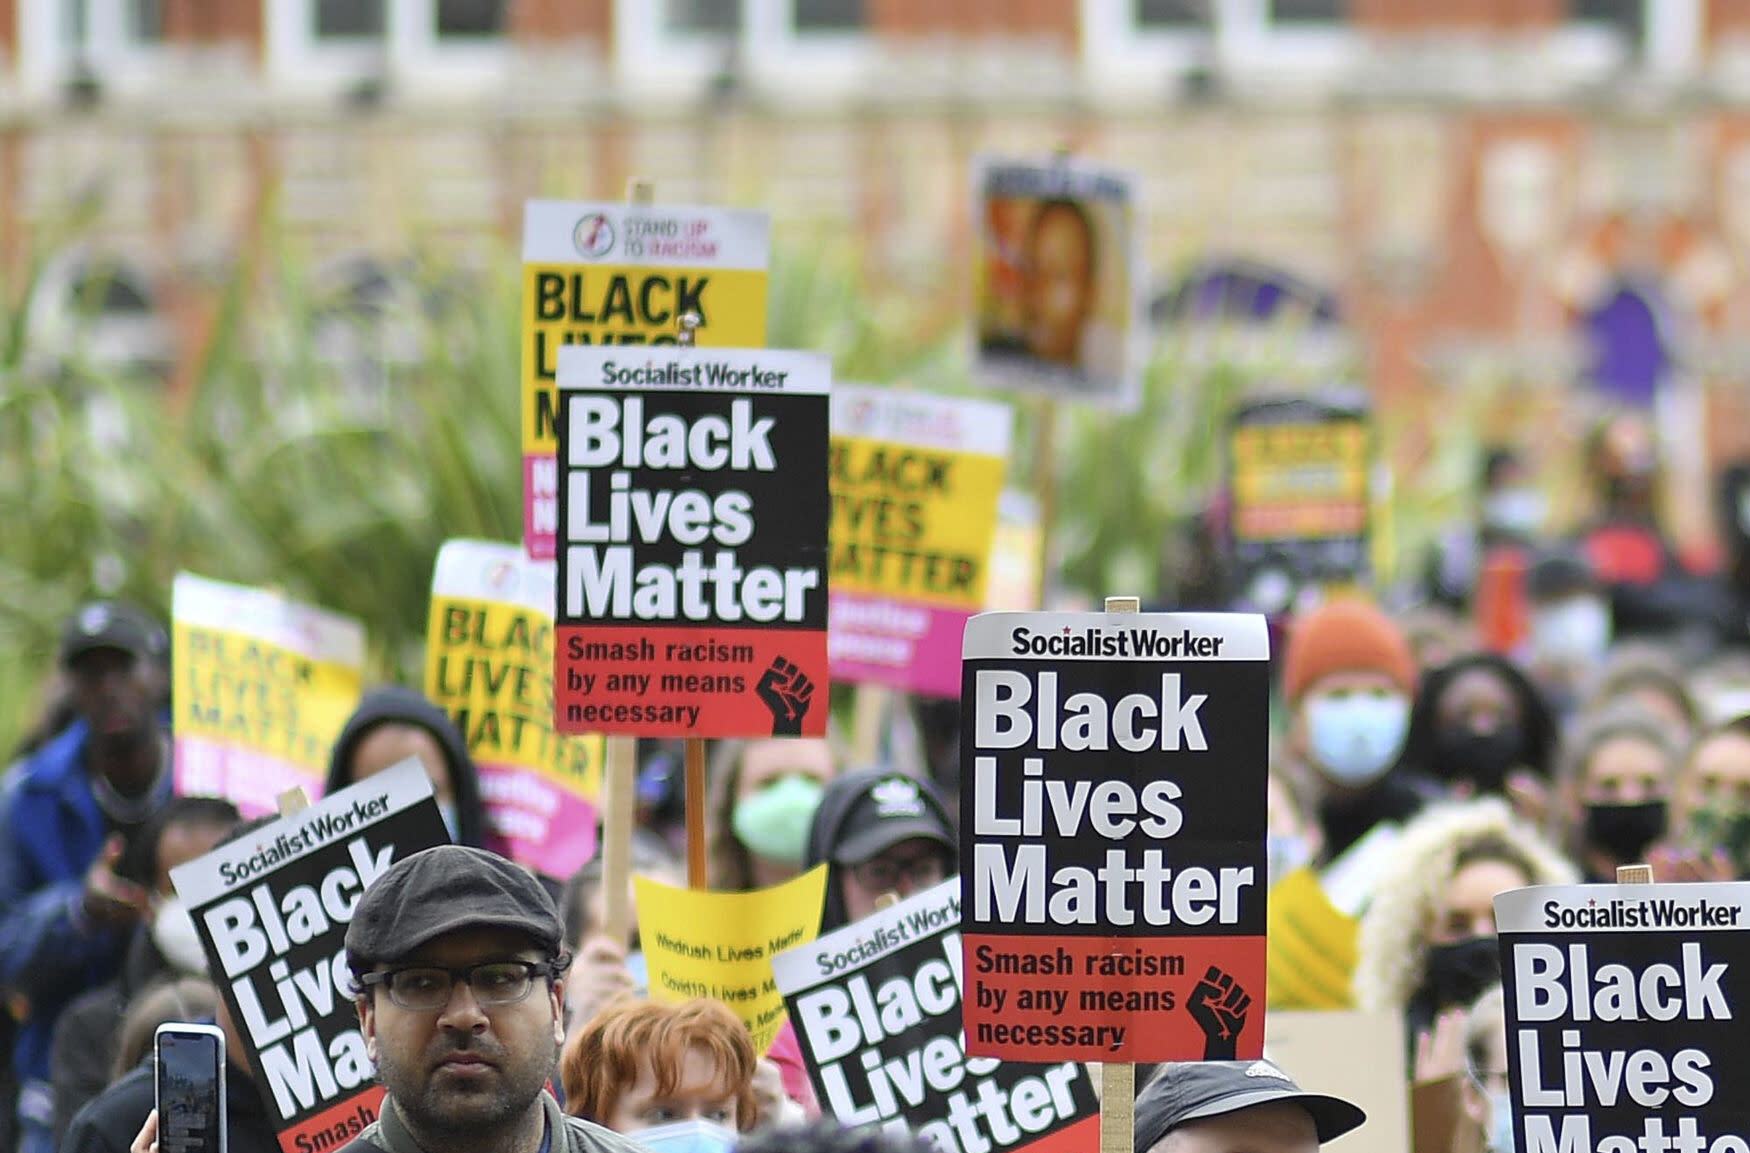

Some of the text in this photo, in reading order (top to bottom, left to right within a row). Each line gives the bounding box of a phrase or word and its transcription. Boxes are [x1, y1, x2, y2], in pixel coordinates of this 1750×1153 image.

[624, 217, 708, 238] STAND UP
[624, 239, 718, 259] TO RACISM
[534, 271, 709, 328] BLACK
[567, 395, 777, 471] Black
[832, 446, 953, 495] LACK
[567, 471, 754, 546] Lives
[565, 545, 819, 622] Matter
[832, 544, 978, 593] ATTER
[568, 636, 754, 664] Smash racism
[568, 667, 746, 694] by any means
[568, 702, 700, 727] necessary
[974, 669, 1208, 752] Black
[974, 756, 1183, 840] Lives
[202, 836, 396, 980] Black
[973, 842, 1254, 926] Matter
[716, 943, 765, 963] Lives
[767, 926, 805, 955] Matter
[976, 945, 1185, 976] Smash racism
[660, 970, 708, 998] Covid19
[712, 984, 758, 1002] Lives
[977, 980, 1175, 1015] by any means
[1512, 942, 1733, 1022] Black
[978, 1022, 1126, 1051] necessary
[1518, 1029, 1714, 1108] Lives
